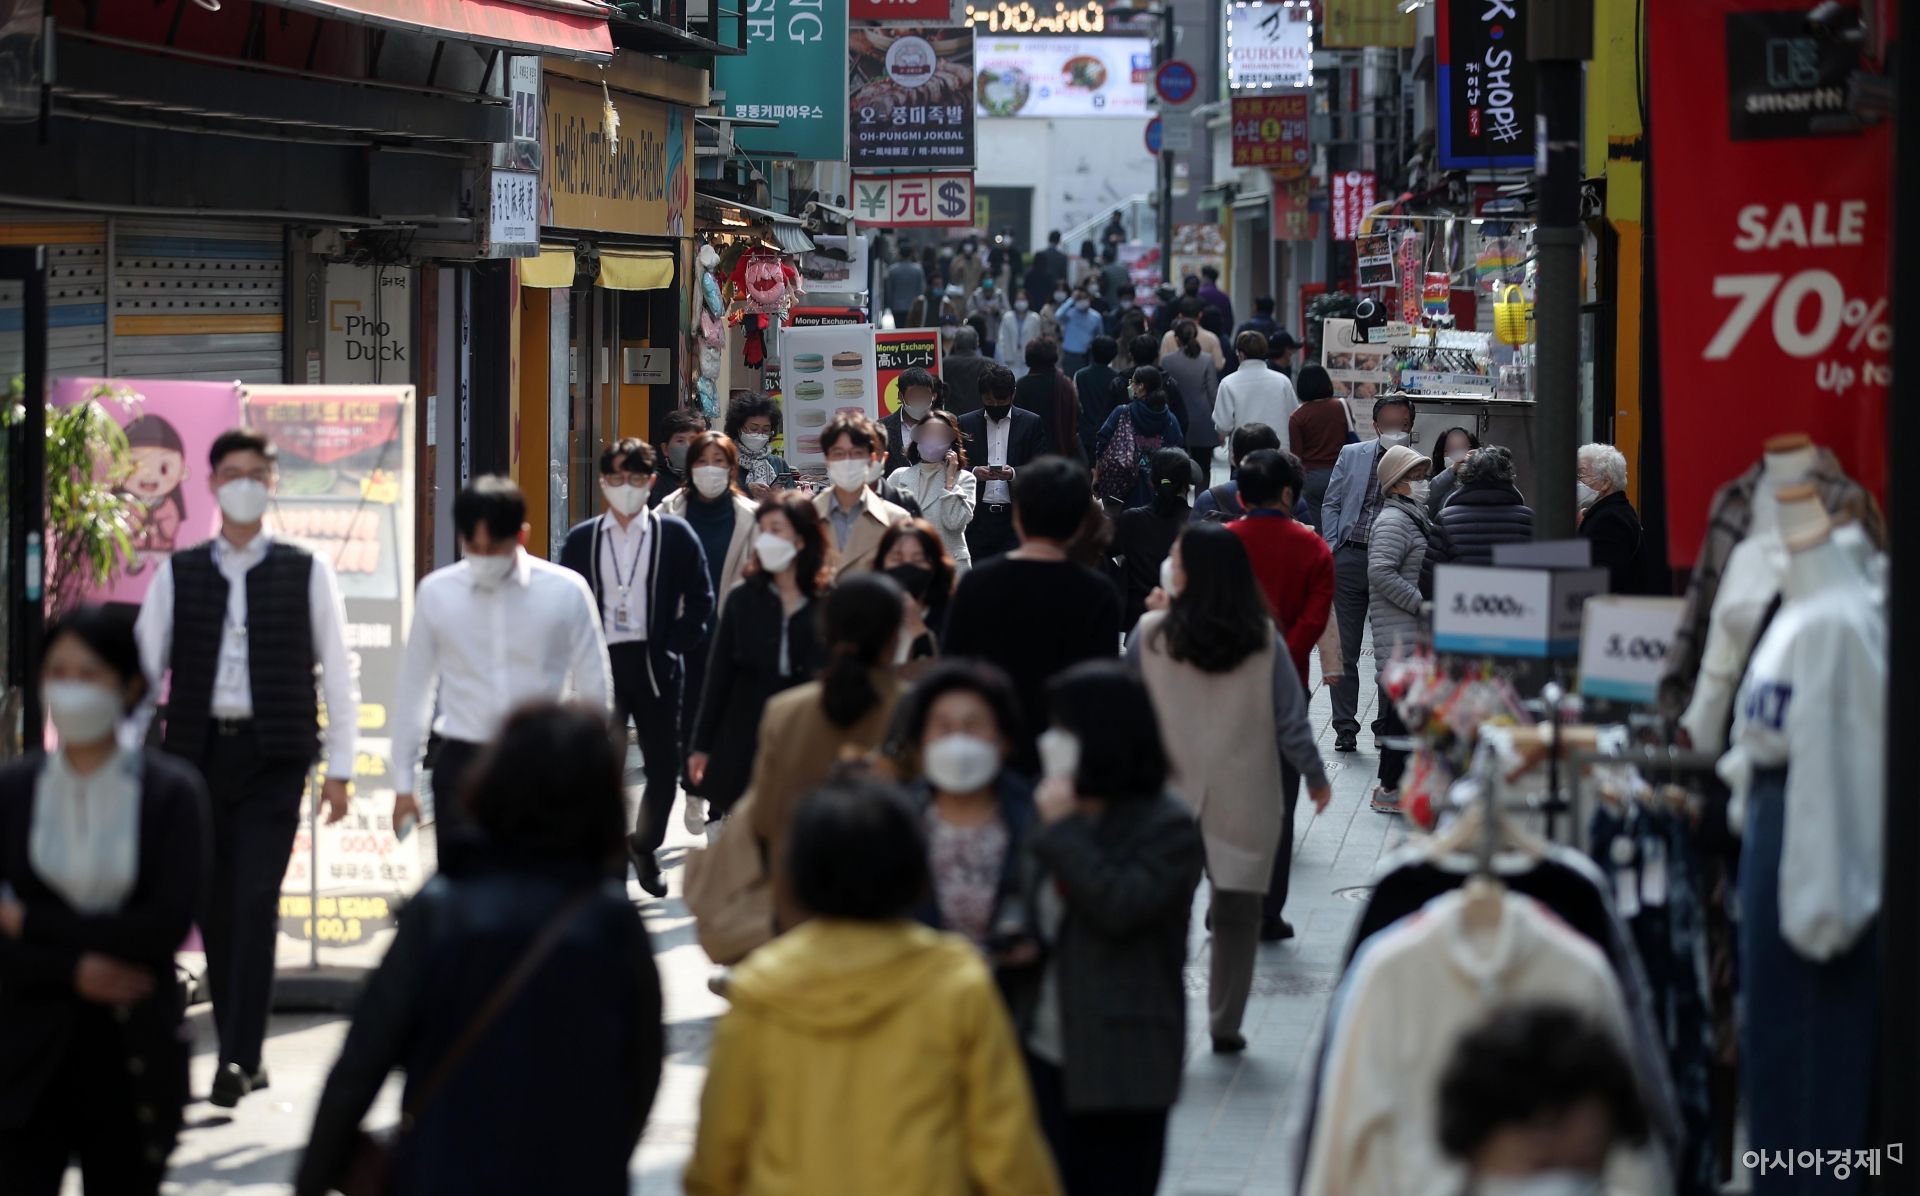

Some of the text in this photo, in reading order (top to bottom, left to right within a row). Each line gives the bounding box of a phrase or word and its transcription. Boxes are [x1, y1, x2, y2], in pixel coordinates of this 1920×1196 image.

[1234, 47, 1304, 60] GURKHA
[736, 104, 823, 119] 명동커피하우스
[860, 131, 964, 141] OH-PUNGMI JOKBAL
[897, 183, 929, 218] 元
[937, 180, 967, 219] $
[1734, 200, 1867, 251] SALE
[795, 317, 858, 326] Money Exchange
[1702, 268, 1893, 361] 70%
[346, 316, 391, 337] Pho
[346, 341, 406, 361] Duck
[877, 342, 935, 353] Money Exchange
[643, 354, 652, 369] 7
[878, 352, 933, 368] 高い レート
[1815, 360, 1894, 396] Up to
